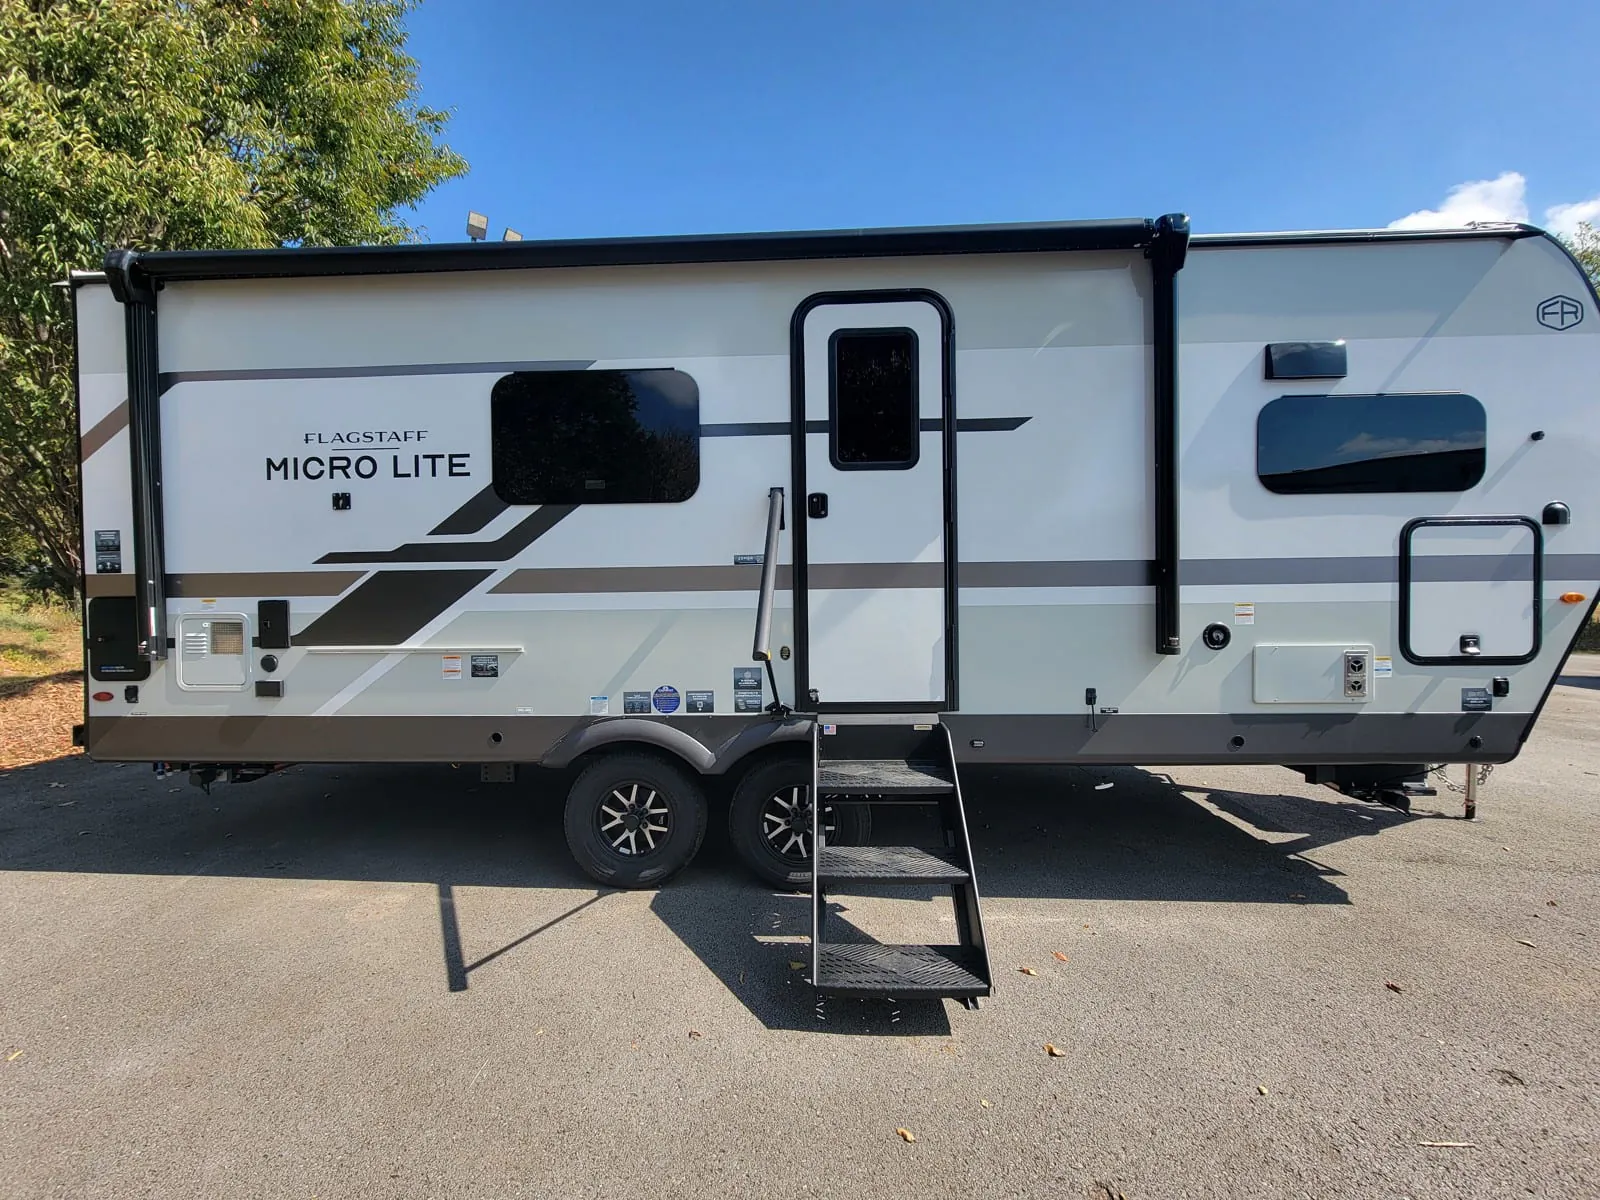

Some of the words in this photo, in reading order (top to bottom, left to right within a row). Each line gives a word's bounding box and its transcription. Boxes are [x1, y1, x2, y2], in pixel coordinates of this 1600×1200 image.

[303, 430, 429, 444] FLAGSTAFF
[266, 455, 378, 480] MICRO
[392, 453, 471, 478] LITE
